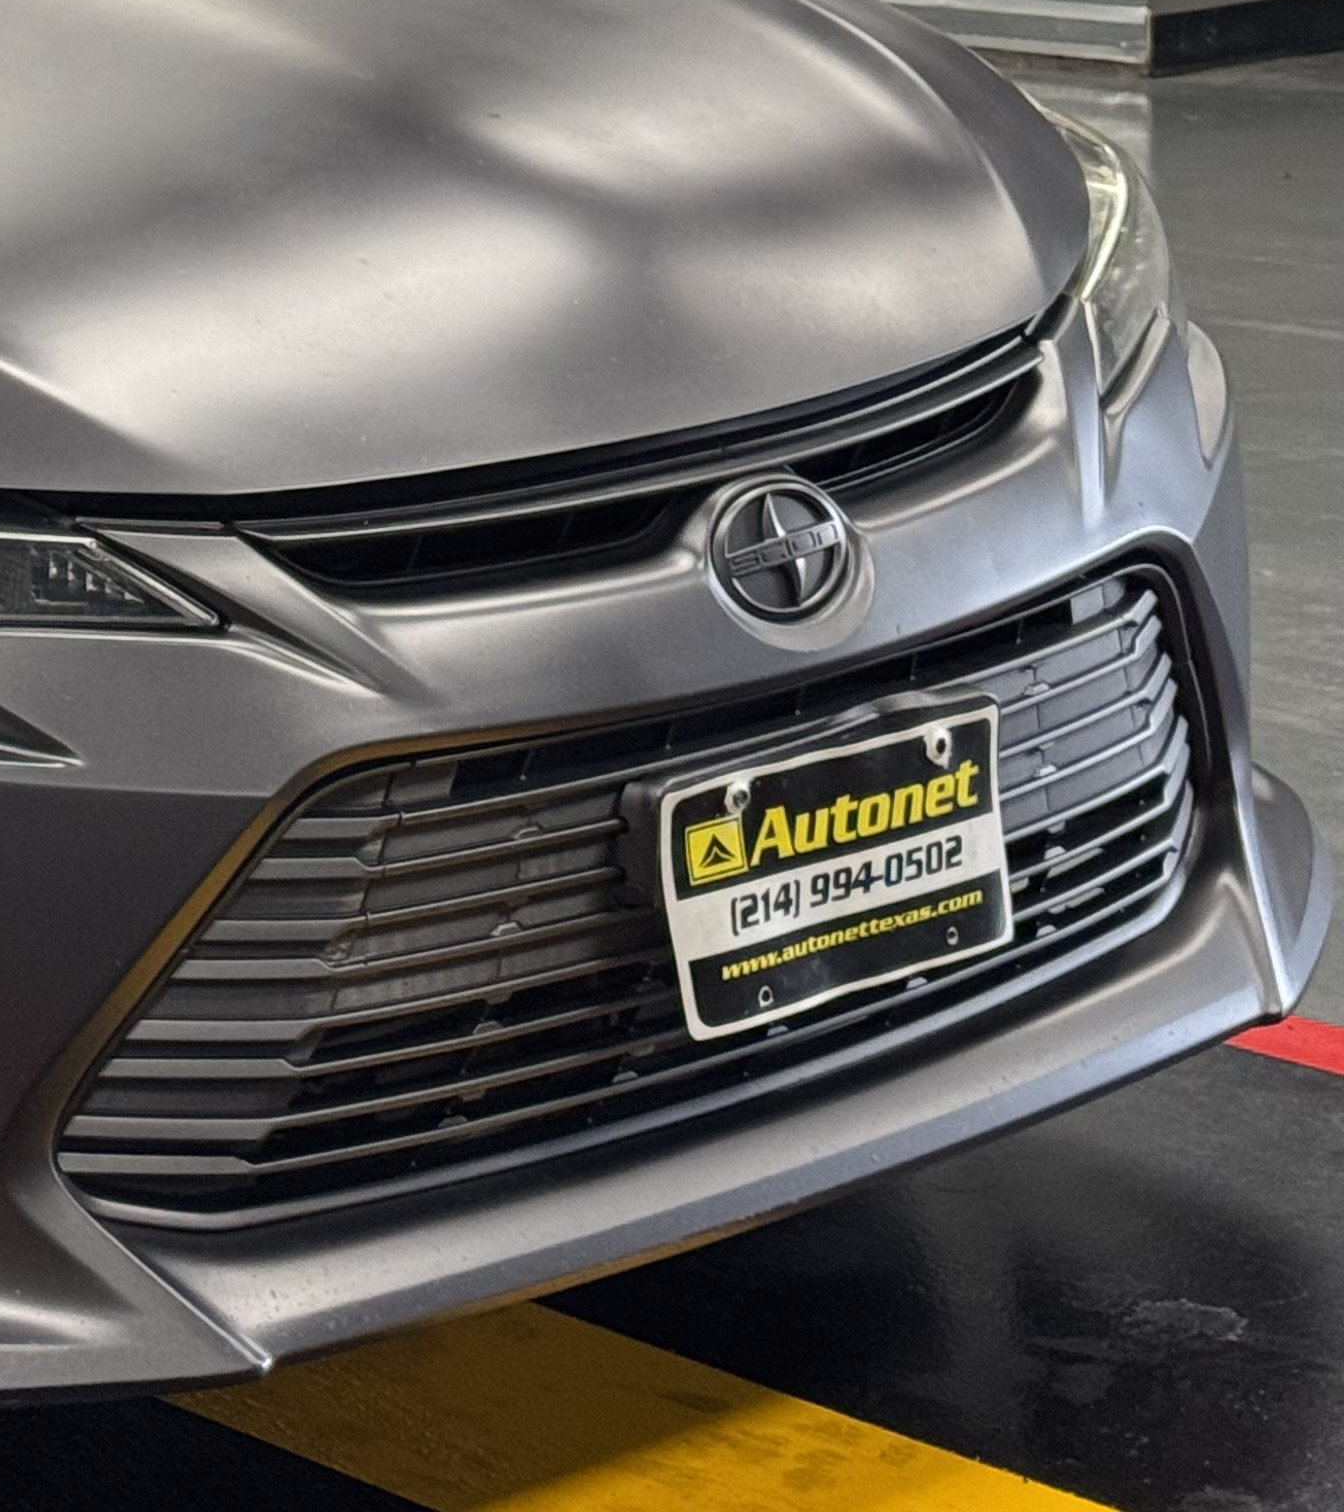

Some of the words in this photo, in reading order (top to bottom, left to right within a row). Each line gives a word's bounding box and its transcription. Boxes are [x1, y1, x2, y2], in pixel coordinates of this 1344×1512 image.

[751, 760, 979, 866] Autonet
[722, 890, 983, 980] www.autonettexas.com
[731, 880, 801, 936] (214)
[810, 835, 963, 908] 994-0502
